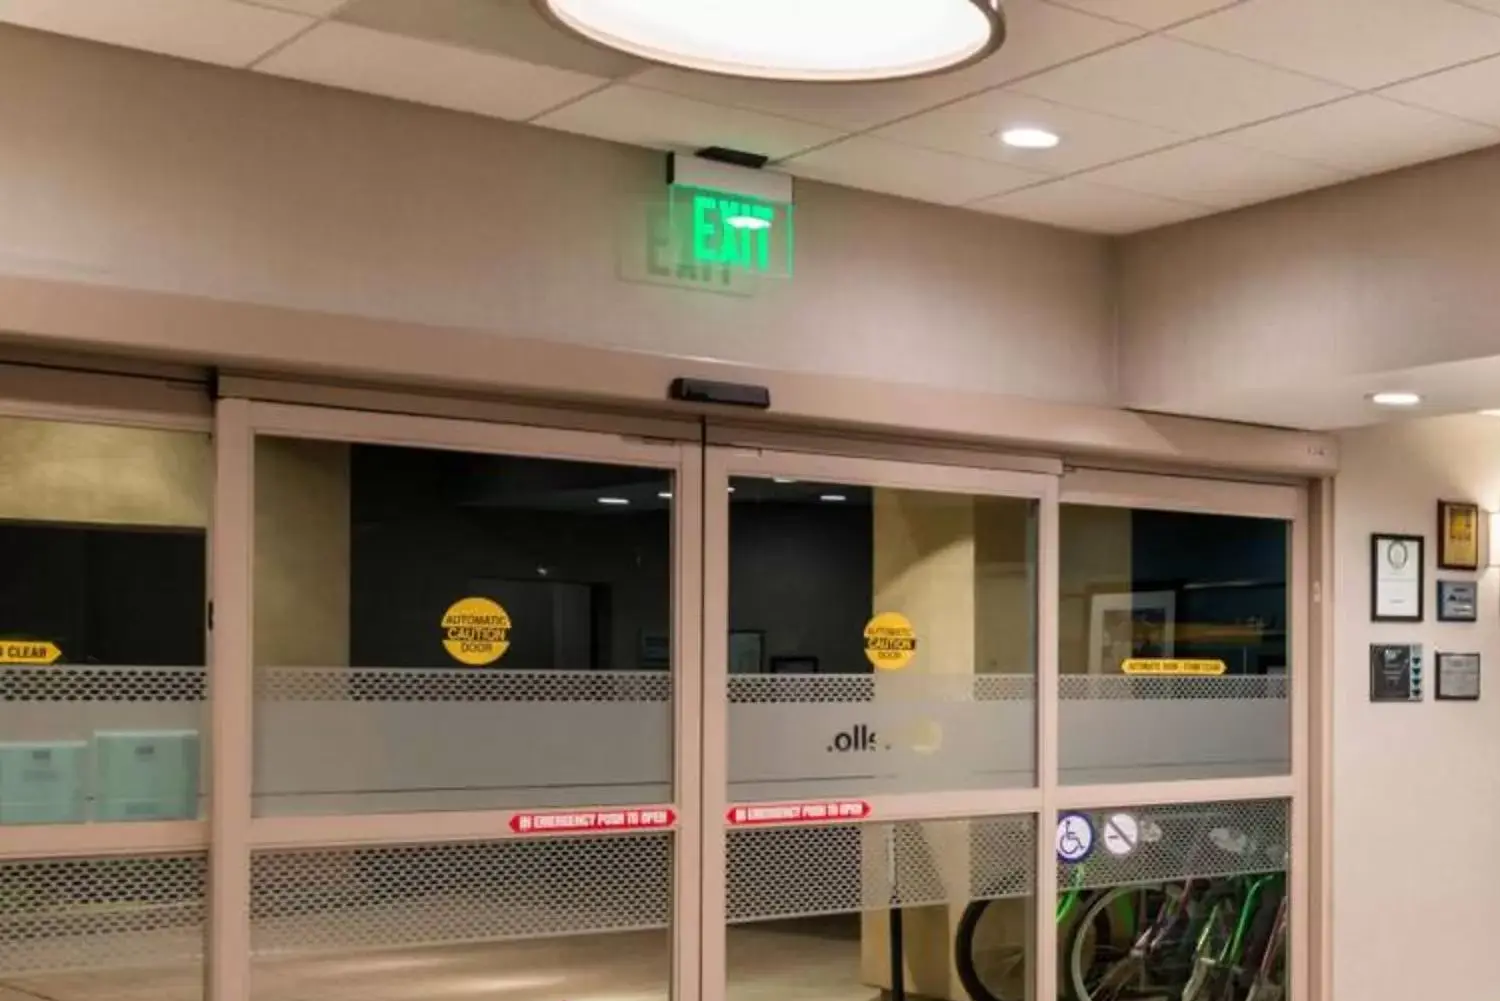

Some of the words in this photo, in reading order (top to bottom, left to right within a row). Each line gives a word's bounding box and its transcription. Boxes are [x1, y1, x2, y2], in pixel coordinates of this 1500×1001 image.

[694, 196, 772, 272] EXIT
[447, 627, 506, 641] CAUTION
[461, 642, 493, 653] DOOR
[868, 637, 911, 650] CAUTION
